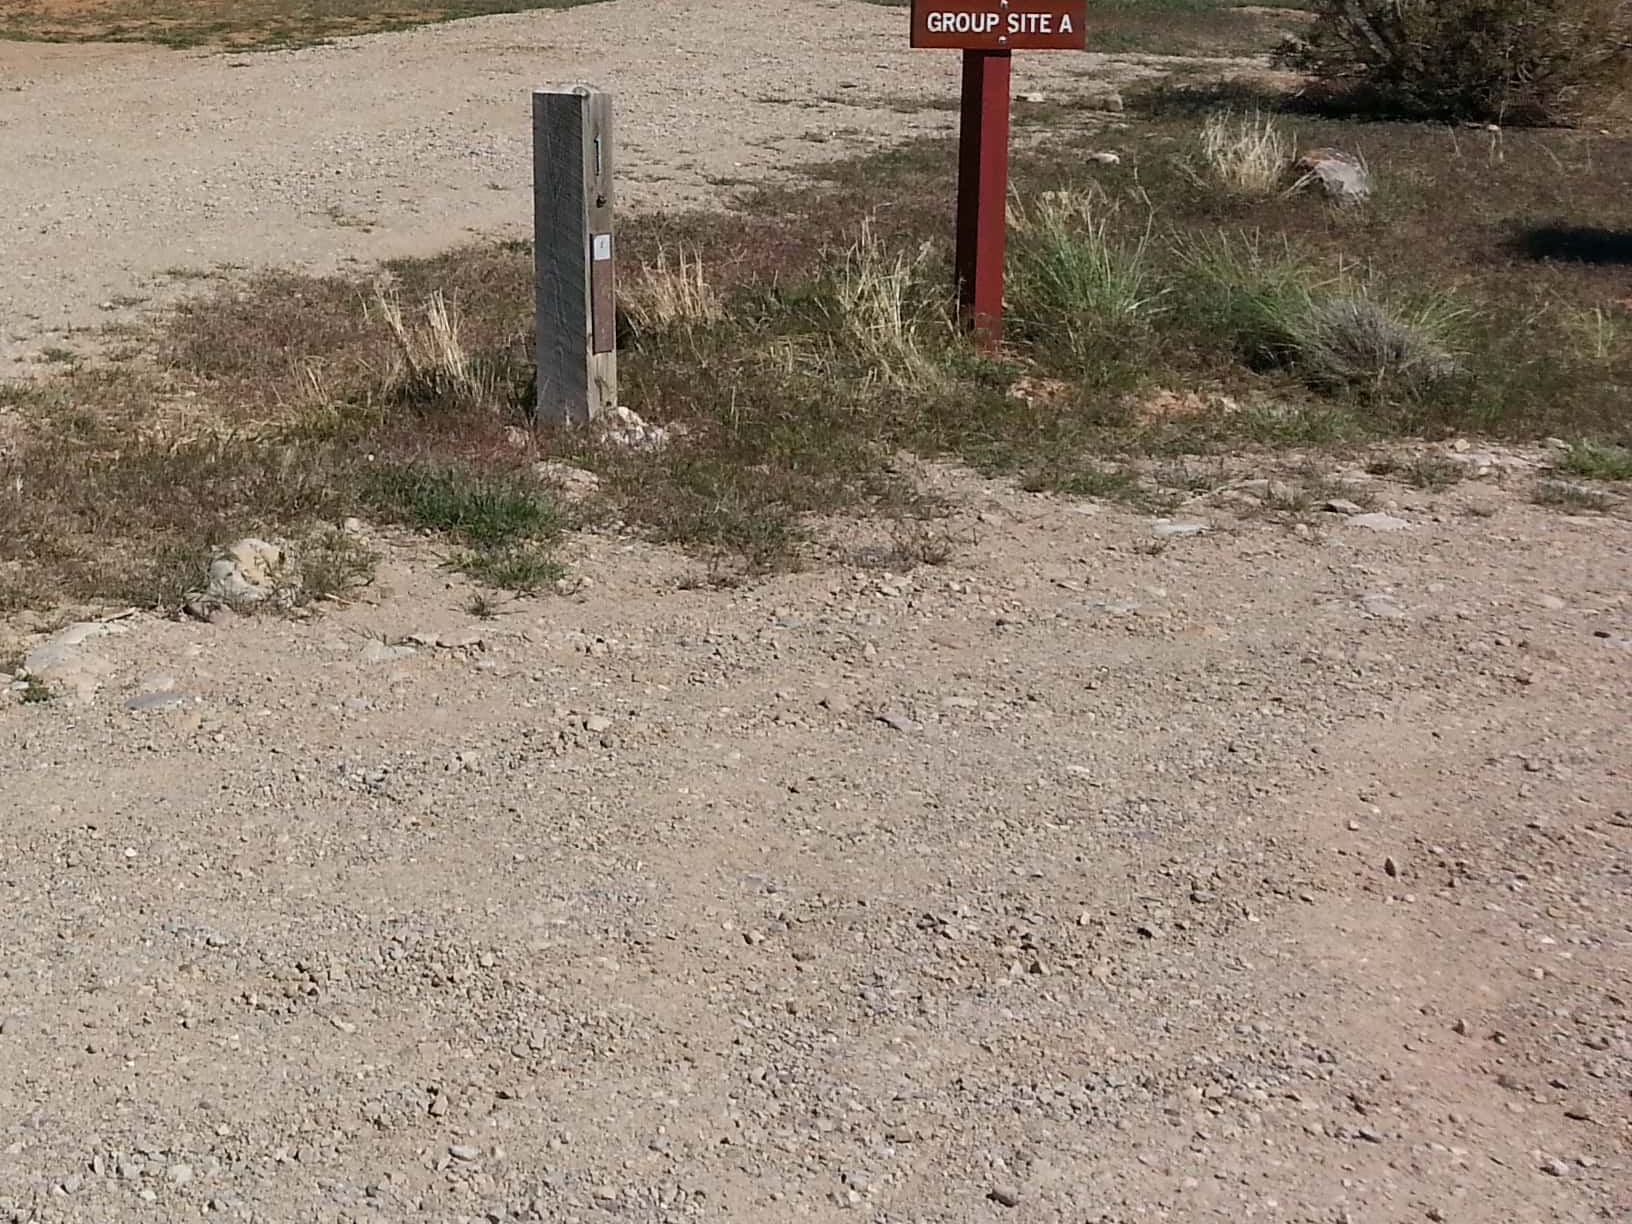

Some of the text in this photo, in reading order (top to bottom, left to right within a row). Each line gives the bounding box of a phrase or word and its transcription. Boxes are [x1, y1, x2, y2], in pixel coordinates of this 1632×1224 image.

[927, 12, 1073, 33] GROUP SITE A
